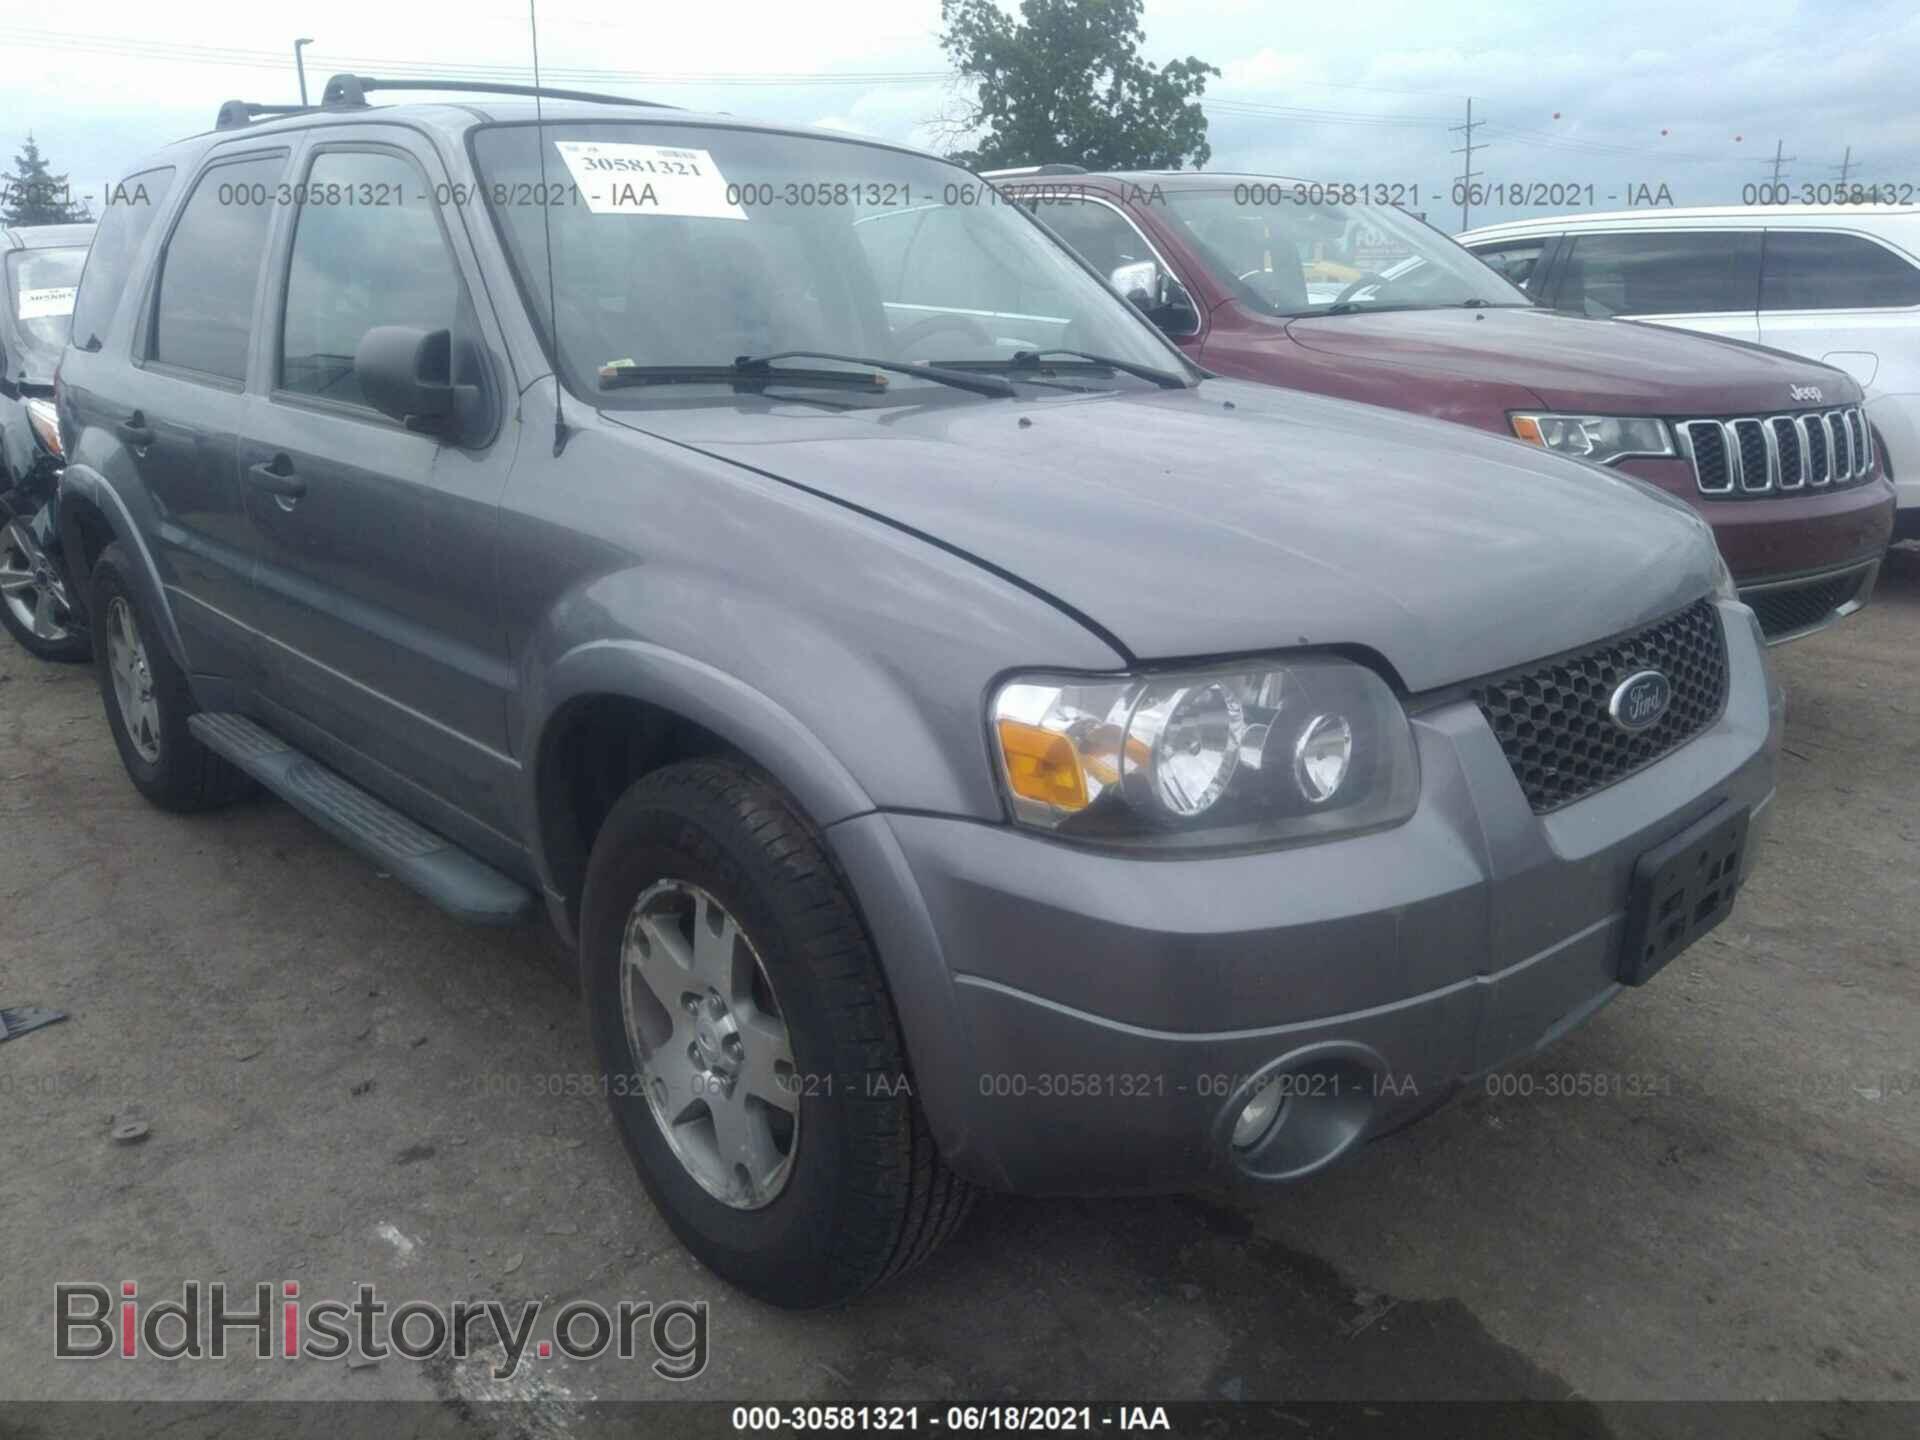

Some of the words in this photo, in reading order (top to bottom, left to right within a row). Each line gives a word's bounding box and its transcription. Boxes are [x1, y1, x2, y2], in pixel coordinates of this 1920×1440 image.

[581, 156, 702, 176] 30581321
[1790, 383, 1823, 403] Jeep
[1630, 682, 1660, 719] Ford
